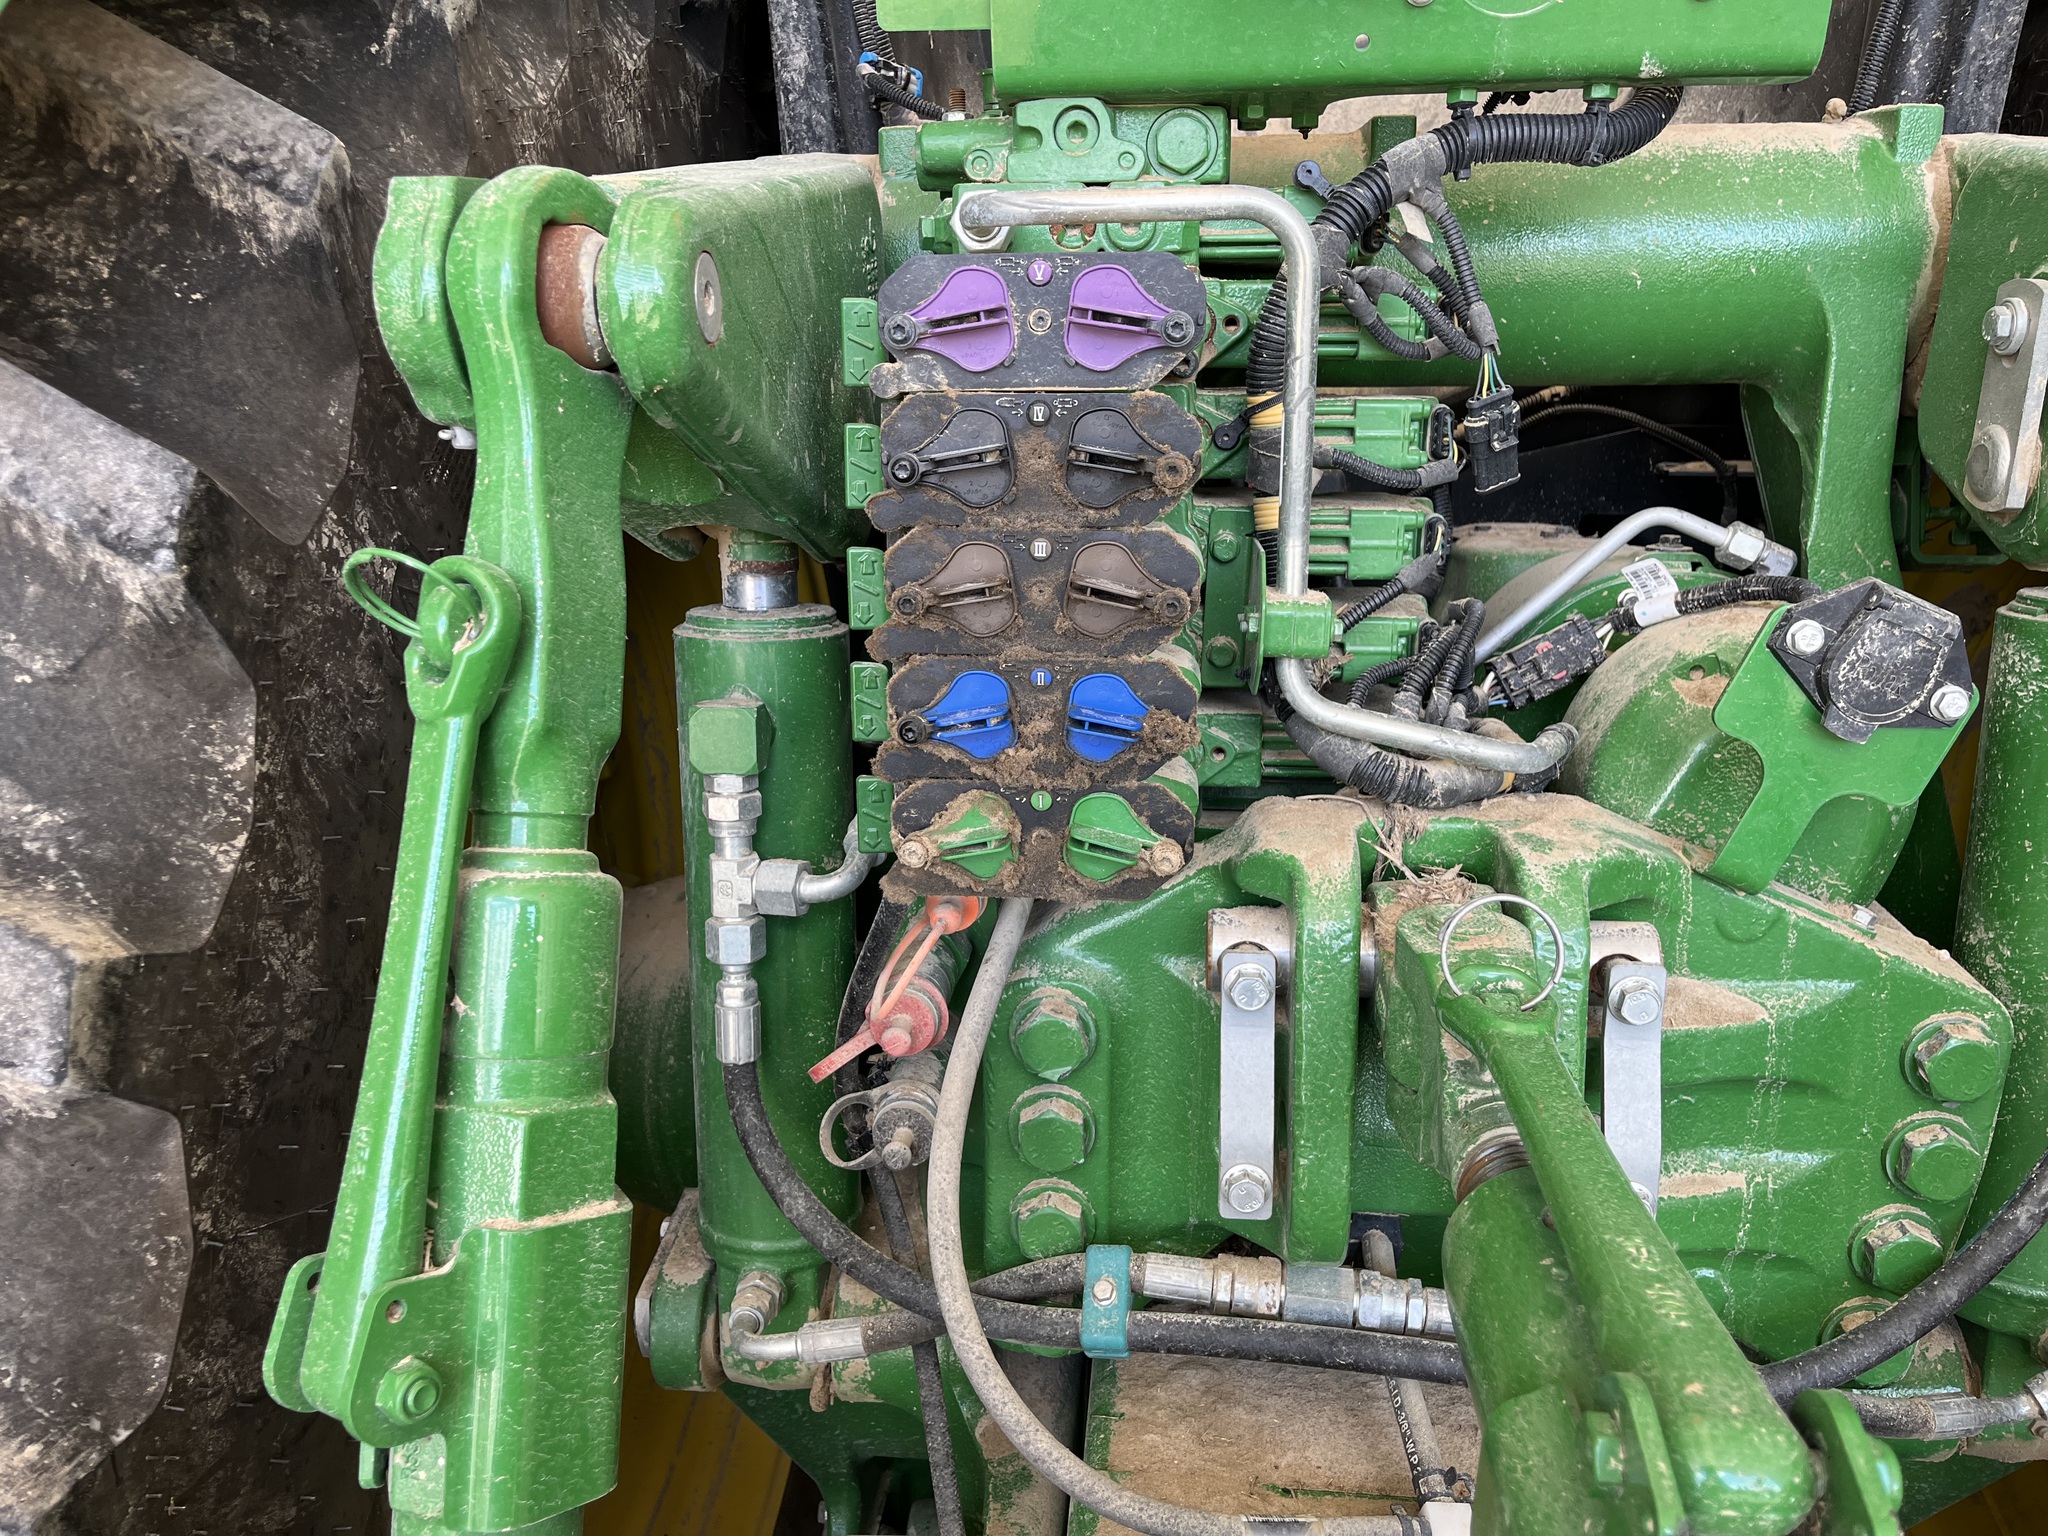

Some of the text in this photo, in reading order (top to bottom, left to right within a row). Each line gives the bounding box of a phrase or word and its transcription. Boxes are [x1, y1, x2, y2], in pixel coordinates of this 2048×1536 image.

[1033, 264, 1045, 281] V
[1033, 406, 1045, 422] IV
[1034, 541, 1047, 557] III
[1036, 671, 1045, 686] II
